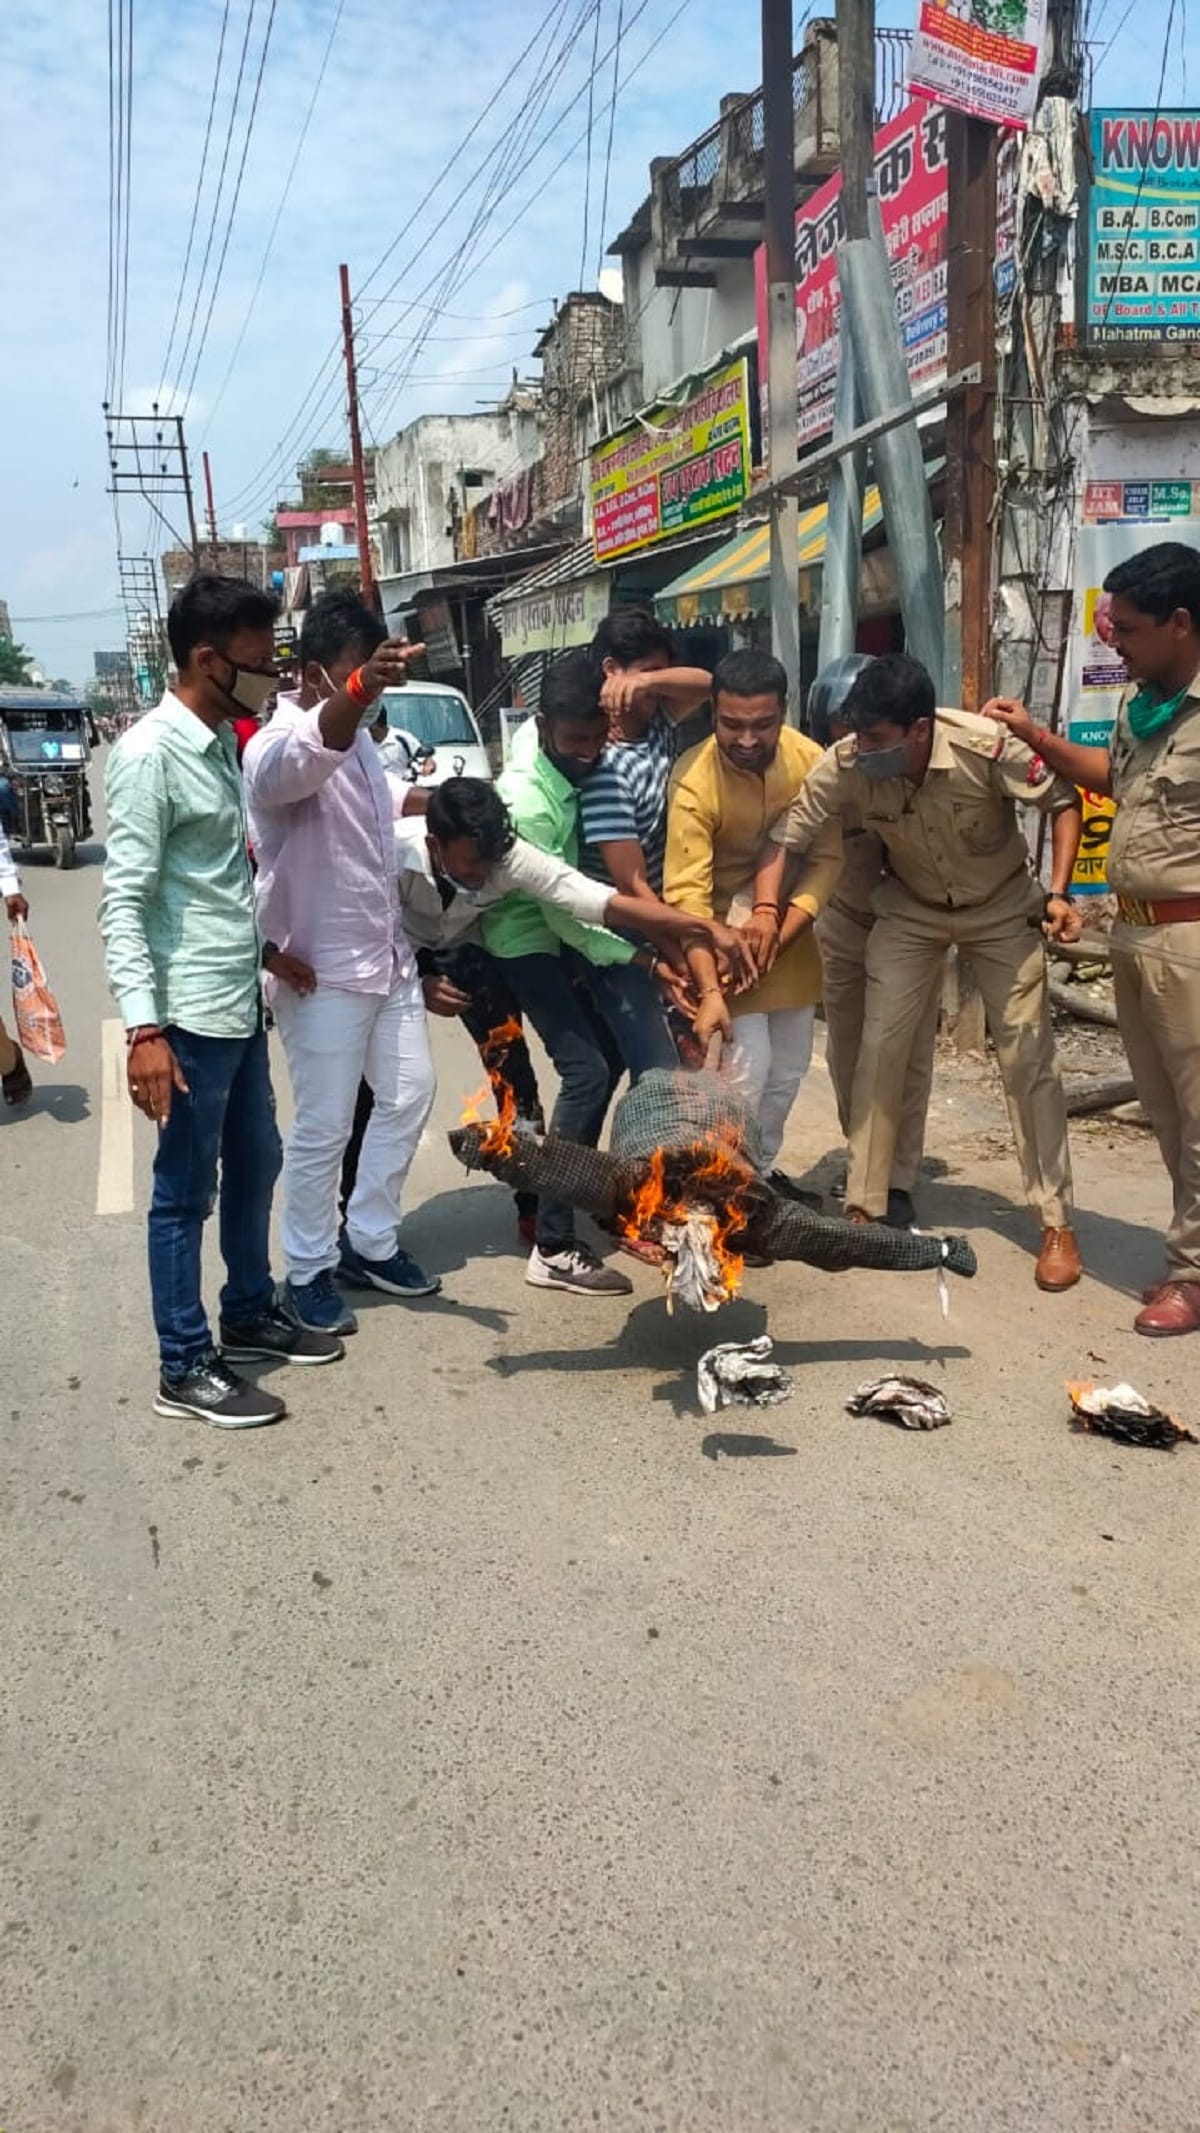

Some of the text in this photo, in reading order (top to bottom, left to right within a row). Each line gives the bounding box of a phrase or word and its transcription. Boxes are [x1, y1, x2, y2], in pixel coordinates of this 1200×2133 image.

[1103, 209, 1196, 228] B.A. B.Com
[1100, 274, 1200, 293] MBA MC
[1094, 326, 1161, 341] Mahatma
